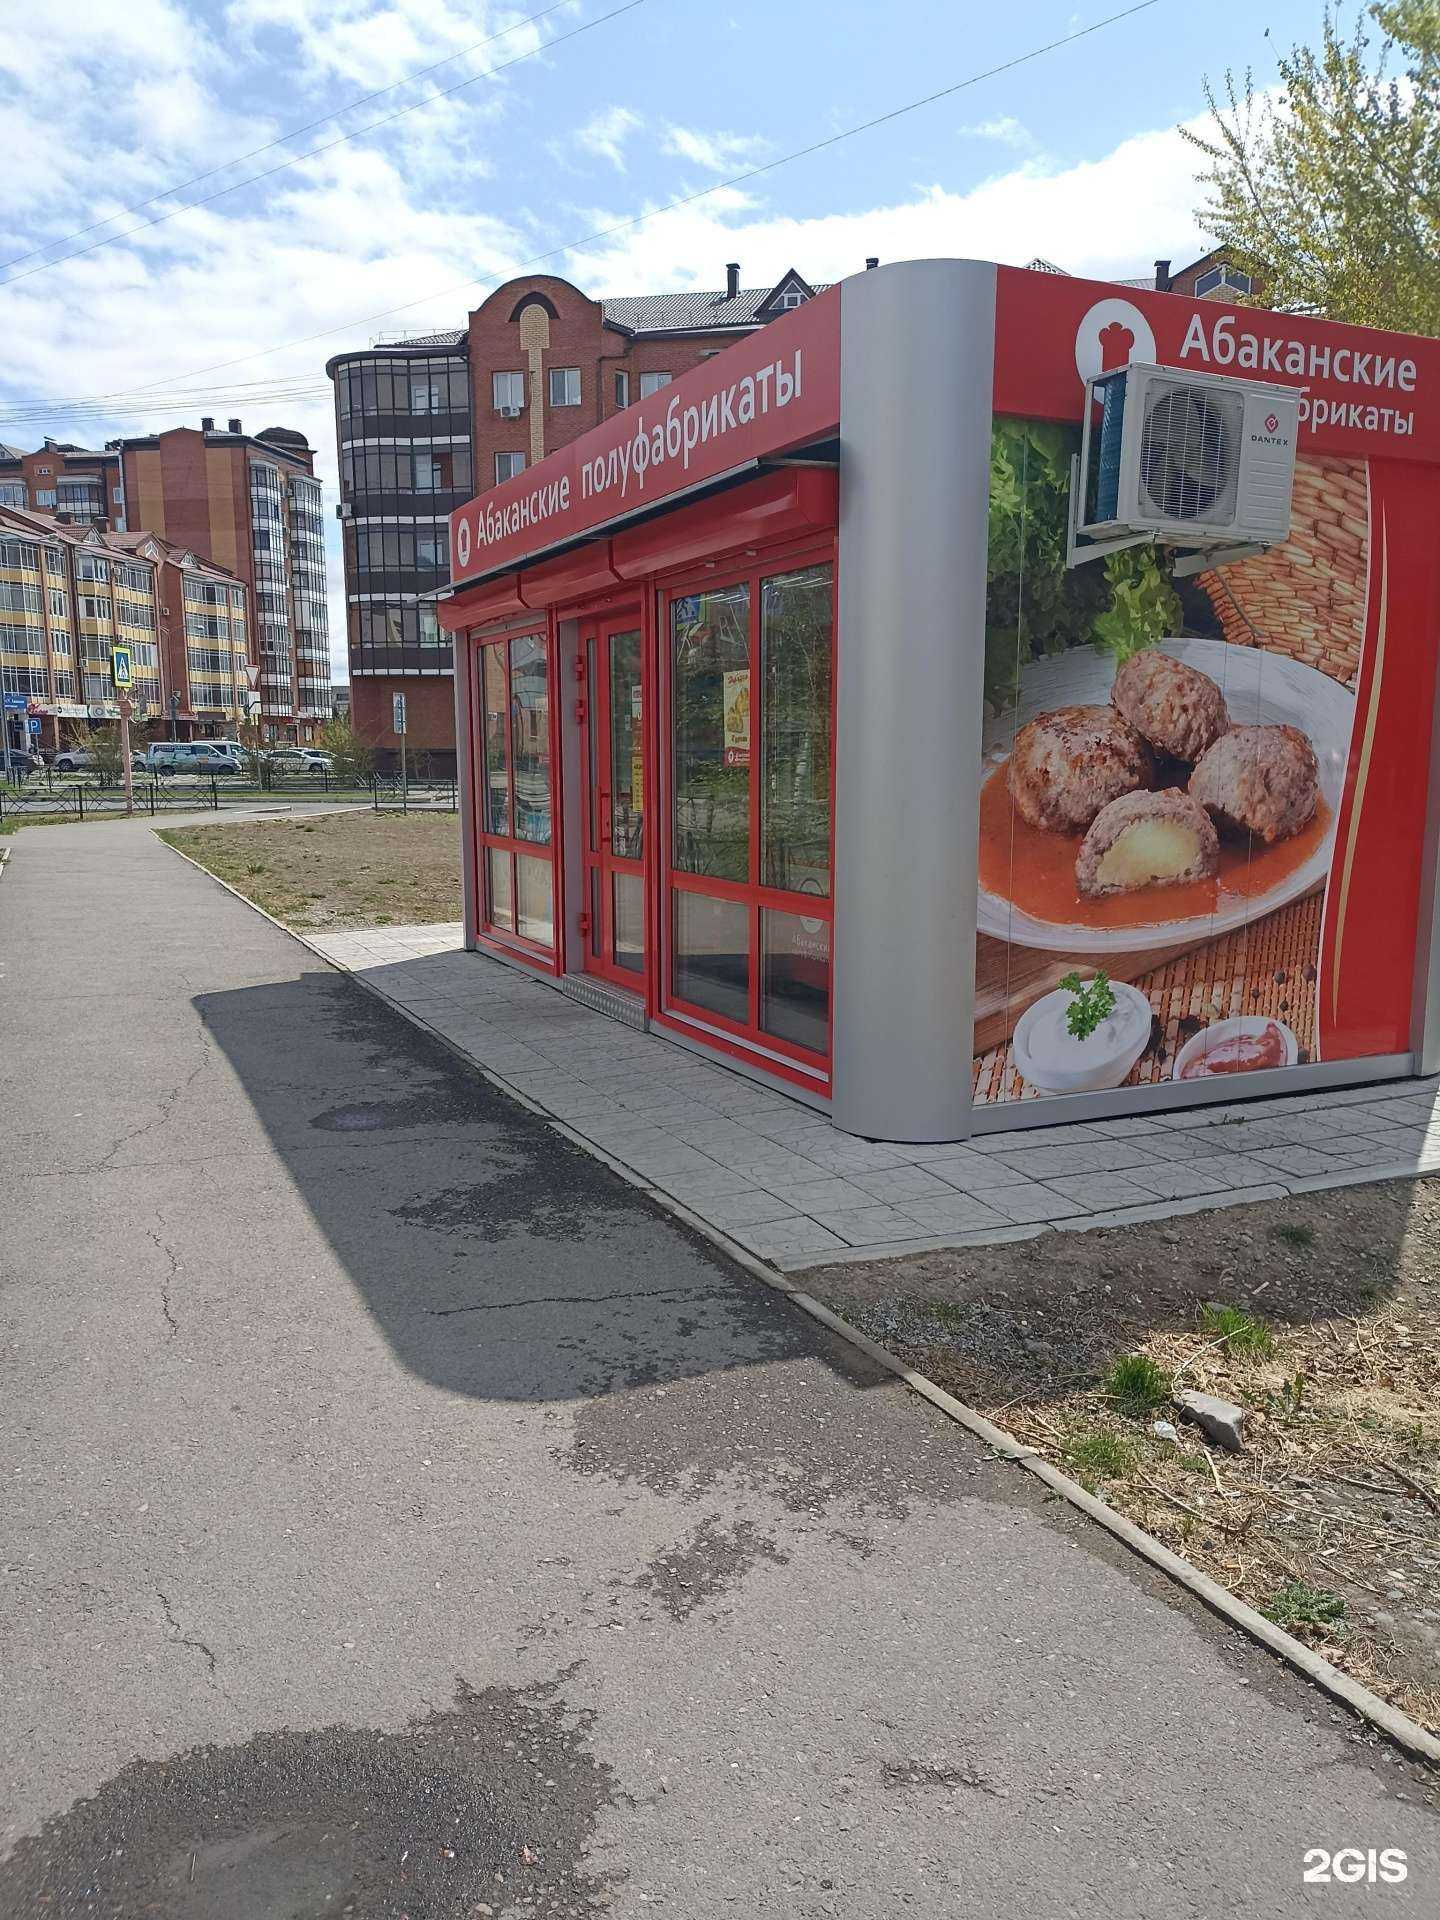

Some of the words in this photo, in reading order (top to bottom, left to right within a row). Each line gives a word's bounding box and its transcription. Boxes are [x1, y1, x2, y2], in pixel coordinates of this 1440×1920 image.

[1179, 313, 1418, 392] Абаканские
[1251, 434, 1289, 447] DANTEX
[1297, 386, 1415, 435] брикаты
[476, 475, 570, 548] Абаканские
[582, 349, 802, 498] полуфабрикаты
